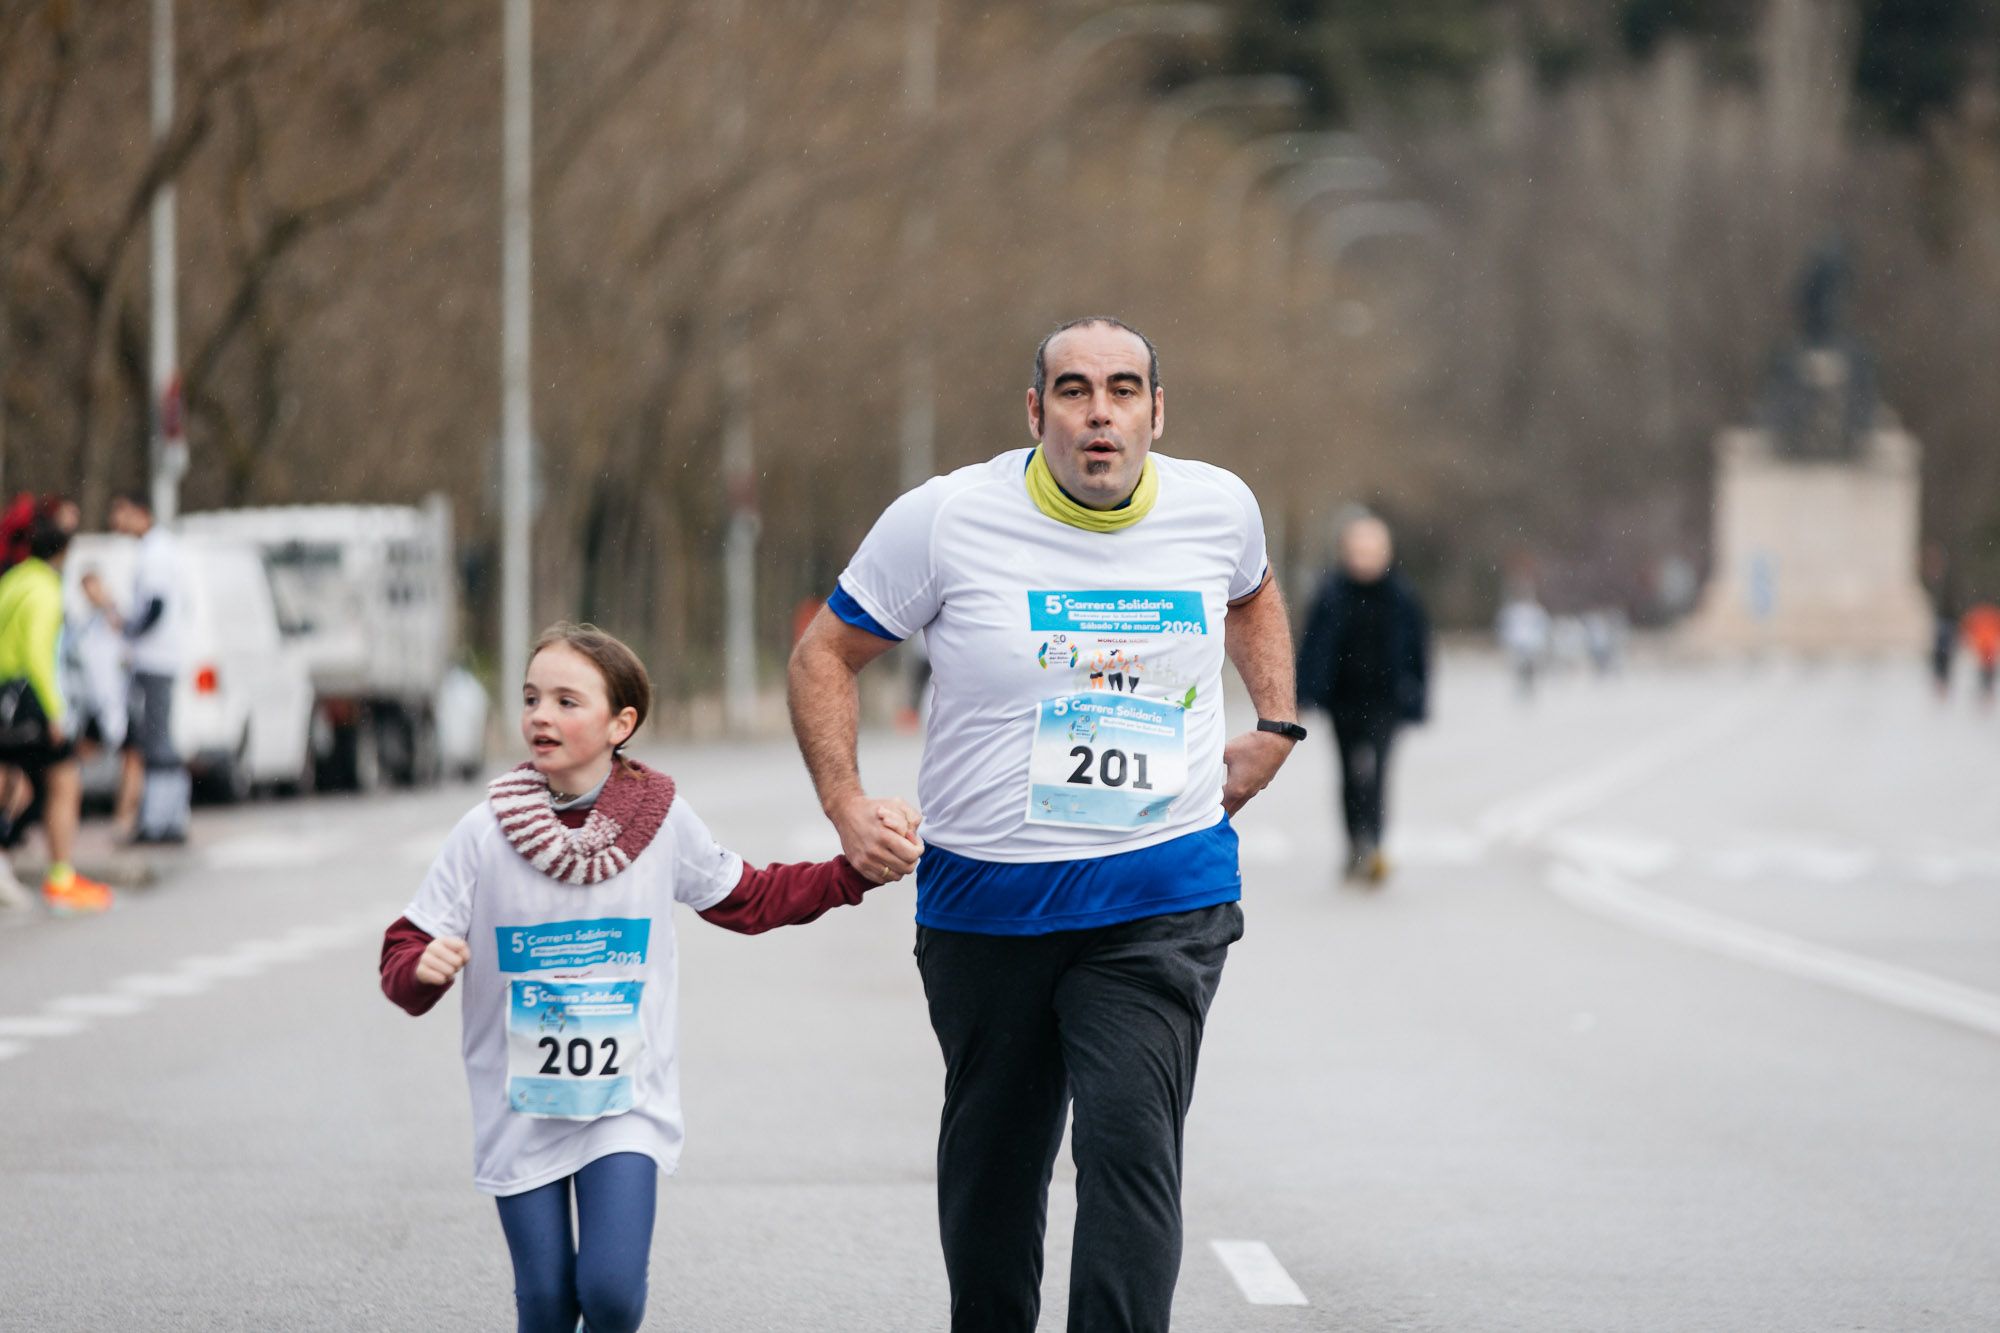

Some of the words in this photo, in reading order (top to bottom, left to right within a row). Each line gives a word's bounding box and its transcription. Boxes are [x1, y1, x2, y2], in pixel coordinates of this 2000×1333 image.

[1064, 598, 1115, 611] Carrera
[1117, 599, 1174, 610] Solidaria
[1080, 622, 1112, 630] Sábado
[1161, 621, 1202, 633] 2026
[1053, 634, 1066, 643] 20
[1071, 700, 1114, 715] Carrera
[1116, 706, 1163, 722] Solidaria
[1067, 745, 1153, 790] 201
[527, 934, 573, 946] Carrera
[575, 928, 623, 941] Solidaria
[540, 991, 579, 1003] Carrera
[581, 991, 625, 1003] Solidaria
[538, 1036, 620, 1077] 202
